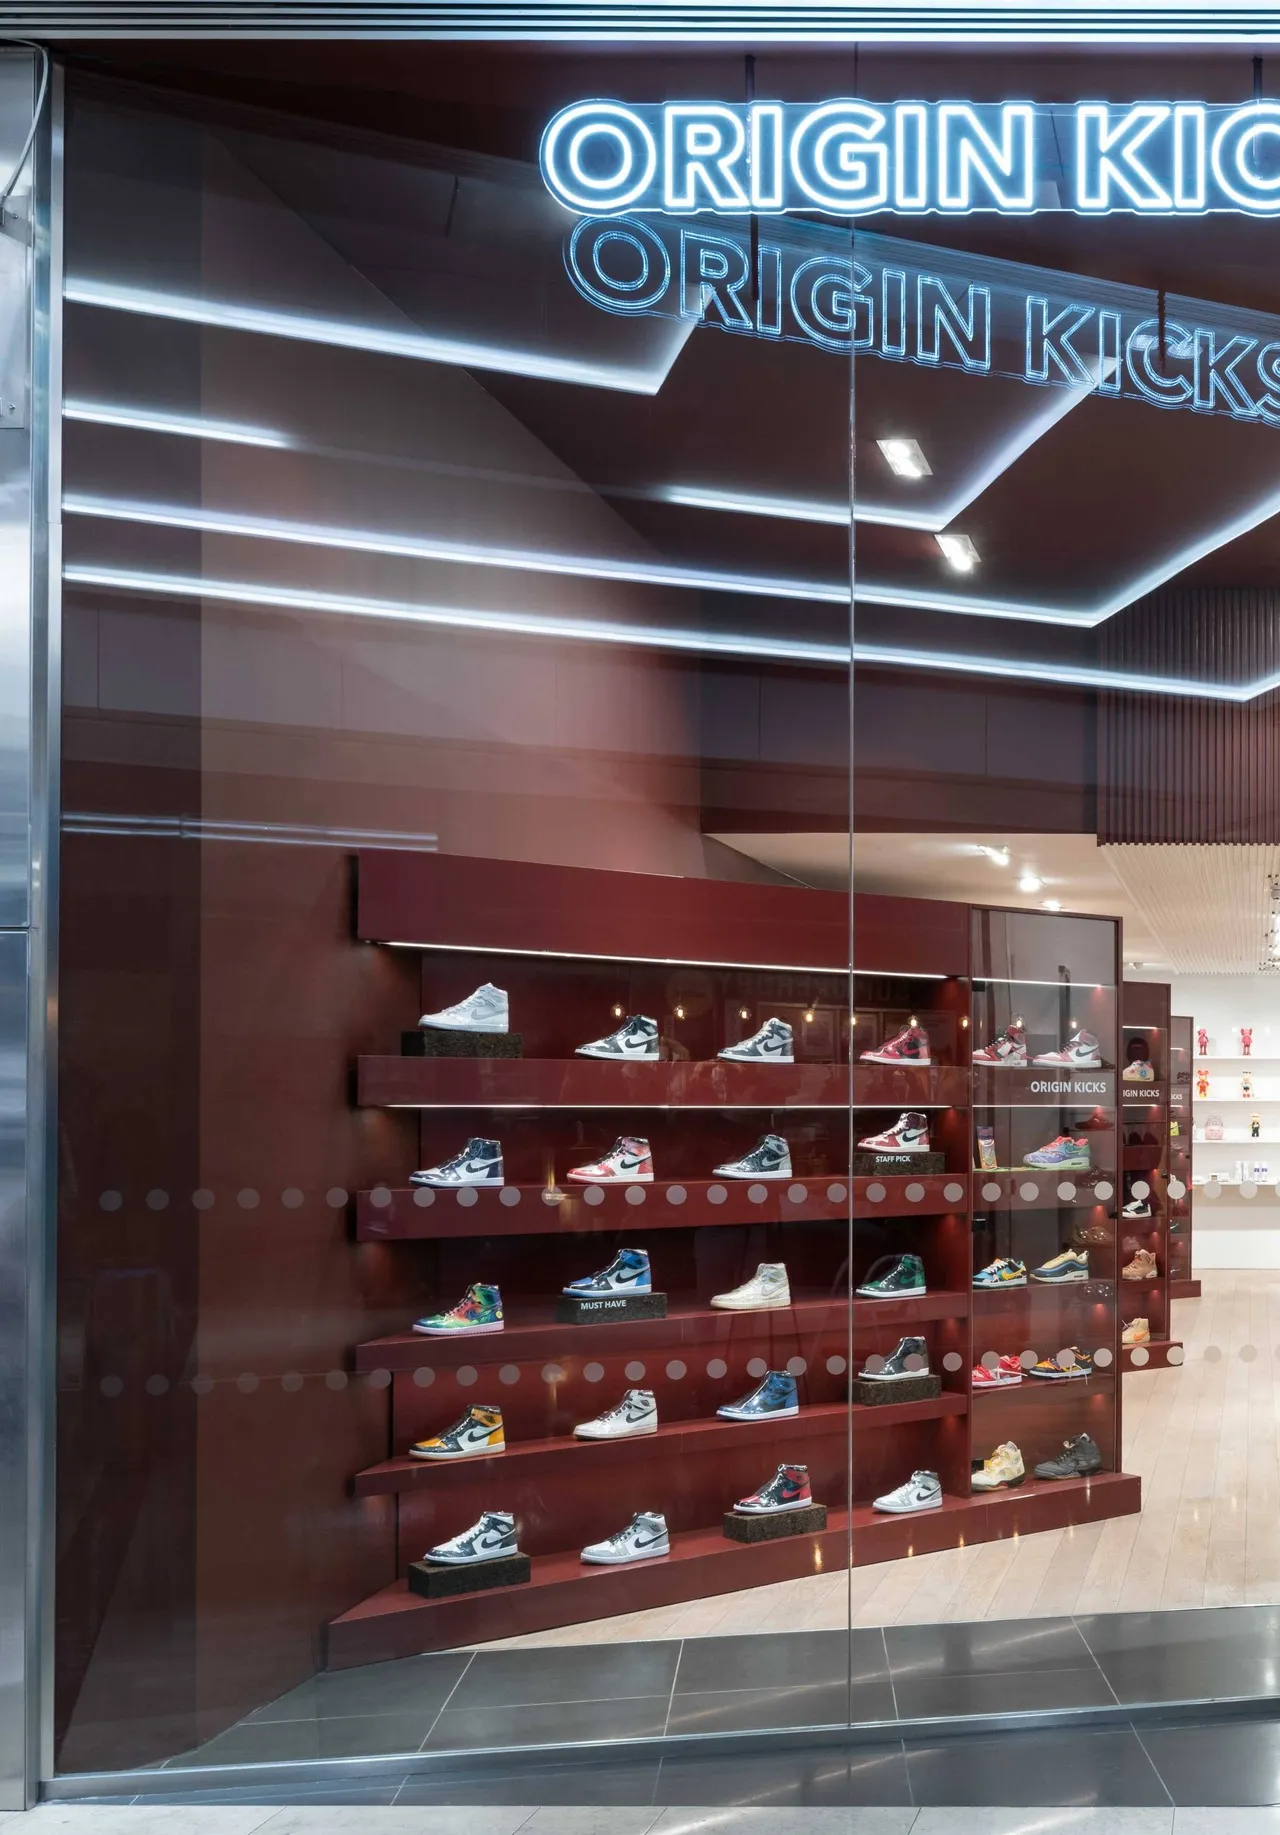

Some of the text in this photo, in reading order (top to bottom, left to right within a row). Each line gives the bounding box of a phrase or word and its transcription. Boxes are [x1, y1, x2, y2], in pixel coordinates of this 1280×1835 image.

[543, 100, 1036, 213] ORIGIN
[569, 216, 991, 371] ORIGIN
[1030, 1081, 1107, 1093] ORIGIN KICKS
[1122, 1089, 1160, 1098] IGIN KICKS
[875, 1155, 895, 1163] STAFF
[580, 1299, 627, 1310] MUST HAVE
